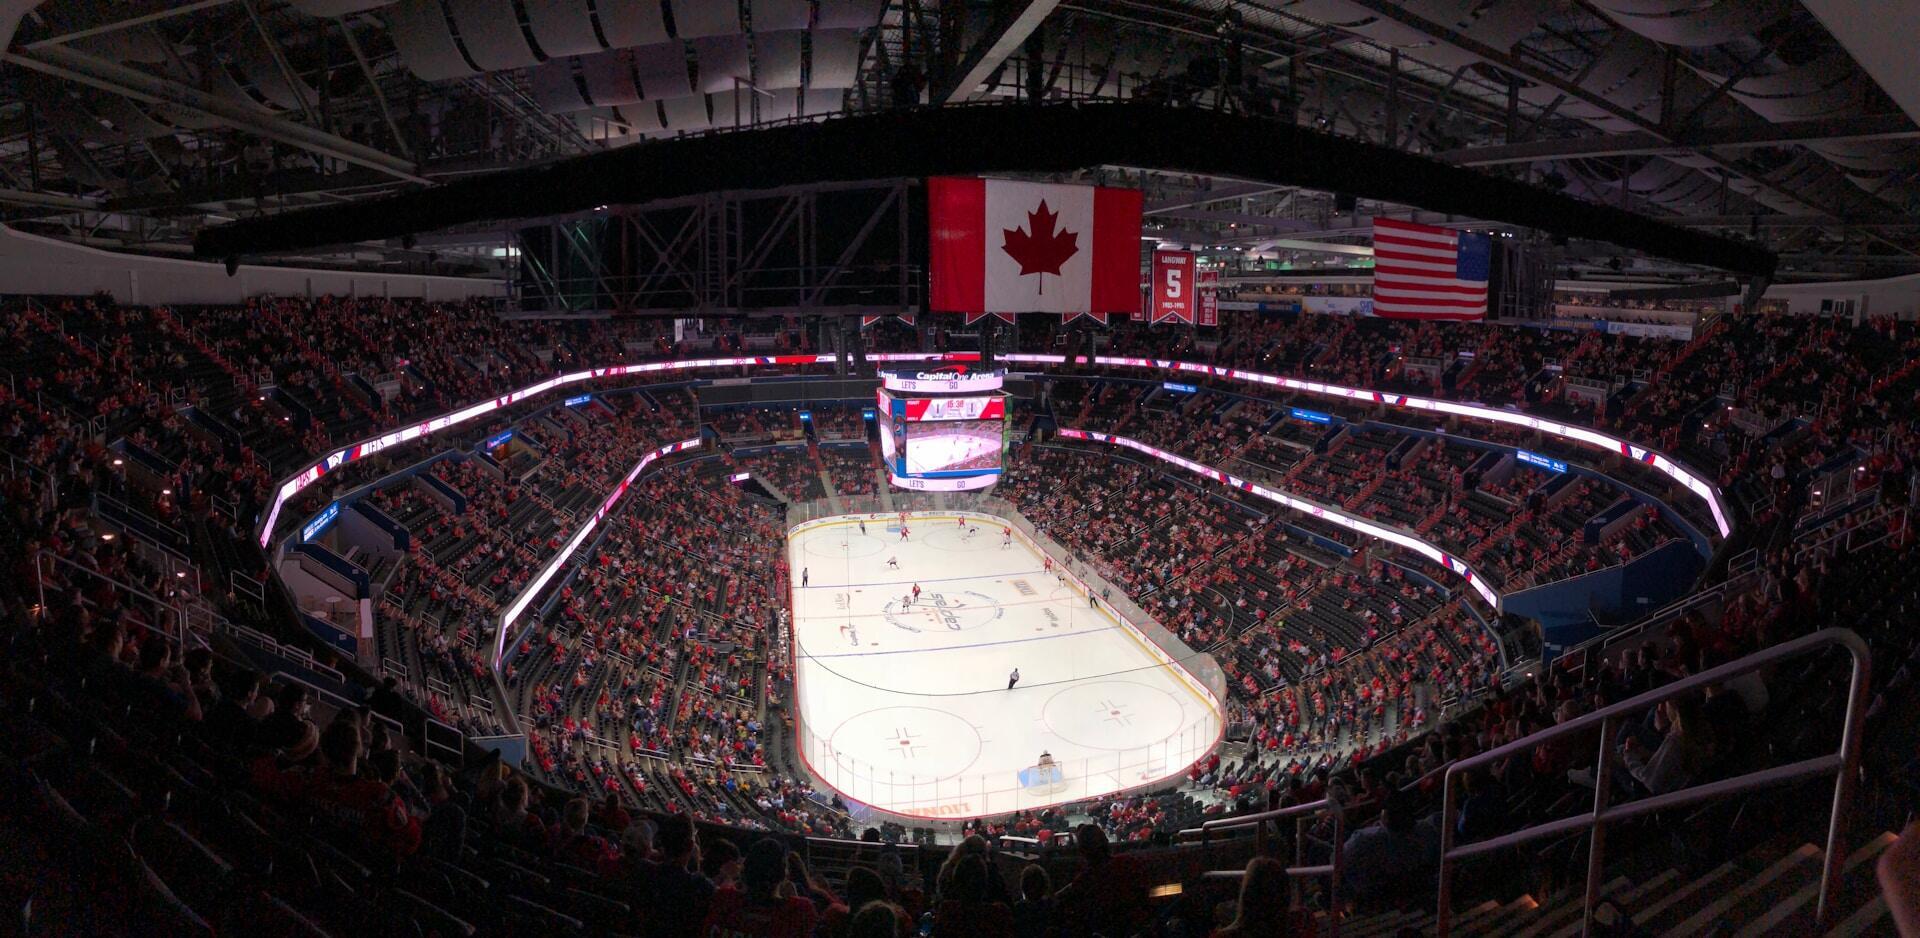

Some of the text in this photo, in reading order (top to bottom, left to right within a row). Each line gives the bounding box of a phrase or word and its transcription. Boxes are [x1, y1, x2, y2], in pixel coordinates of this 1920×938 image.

[1161, 255, 1187, 264] LANGWAY
[1166, 269, 1182, 298] 5
[901, 381, 959, 390] LET'S GO
[909, 479, 966, 489] LET'S GO
